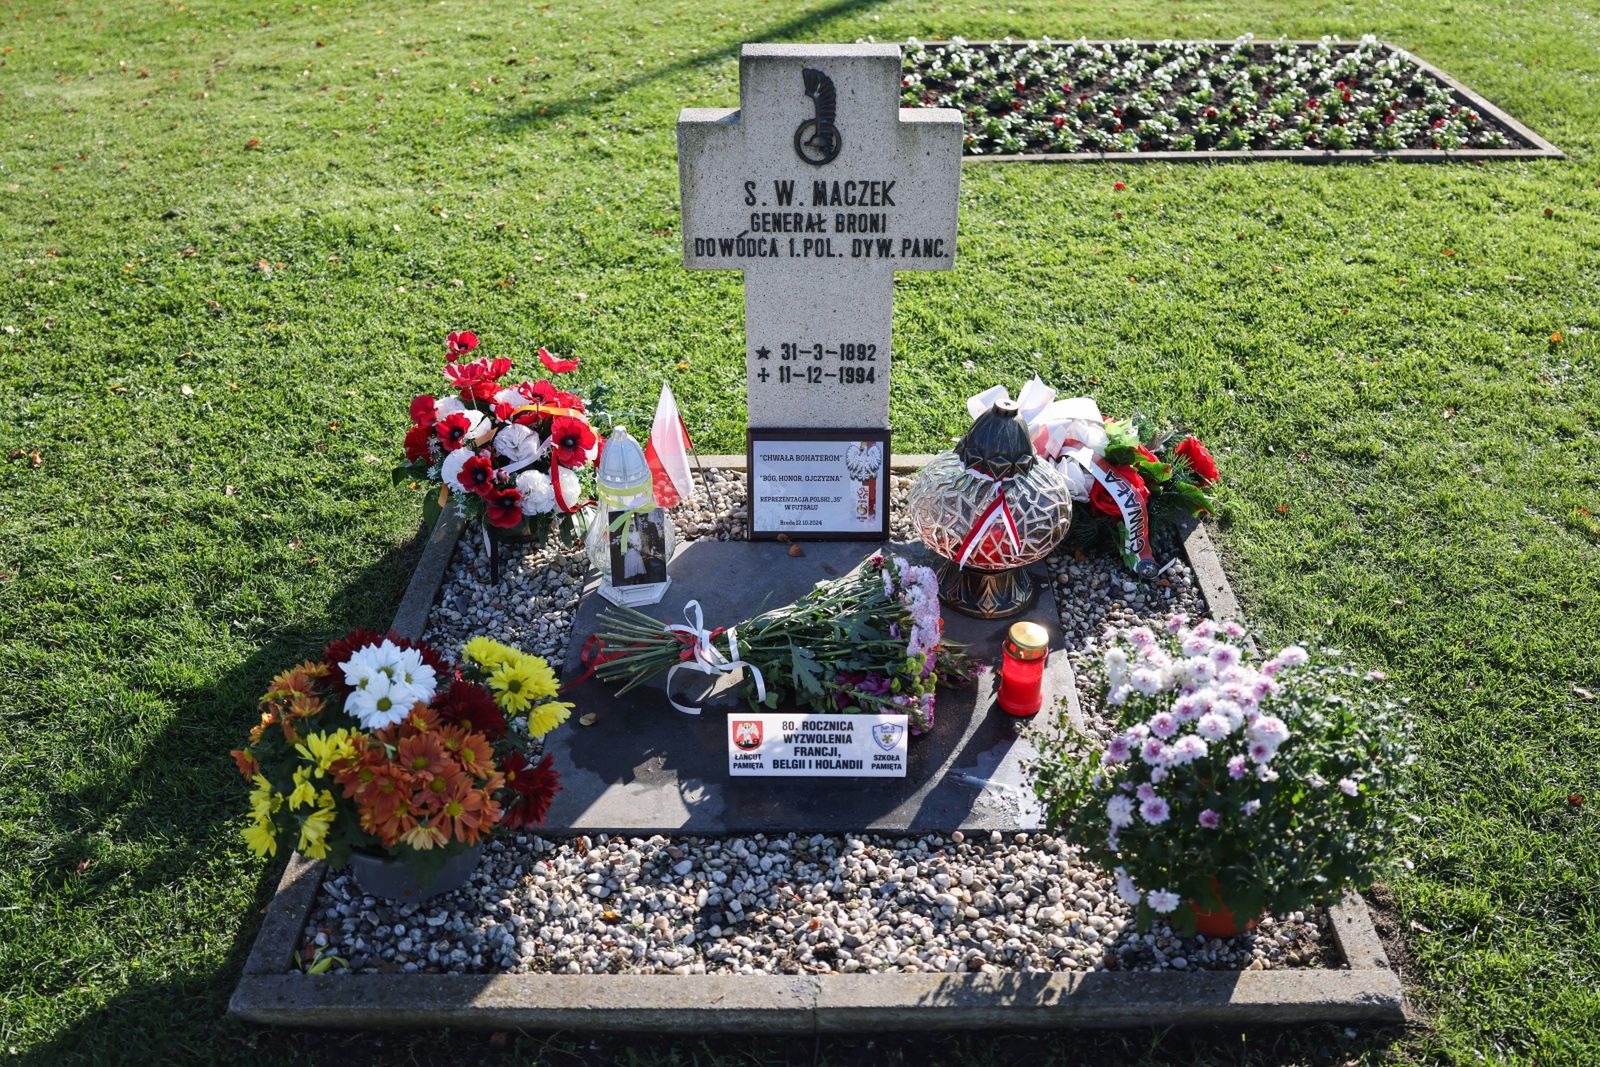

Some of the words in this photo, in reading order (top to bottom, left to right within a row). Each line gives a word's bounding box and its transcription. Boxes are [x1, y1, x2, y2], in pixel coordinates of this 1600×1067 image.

[743, 180, 767, 207] S.
[773, 179, 804, 207] W.
[812, 180, 896, 207] MACZEK
[751, 212, 827, 233] GENERAŁ
[835, 213, 887, 233] BRONI
[694, 230, 779, 258] DOWÓDCA
[851, 238, 896, 258] DYW.
[901, 238, 950, 258] PANC.
[1104, 468, 1146, 554] CHWAŁA
[782, 720, 799, 732] 80.
[802, 720, 854, 732] ROCZNICA
[783, 733, 853, 745] WYZWOLENIA
[734, 753, 762, 761] ŁAŃCUT
[794, 746, 842, 759] FRANCJI,
[873, 754, 900, 762] SZKOŁA
[733, 762, 764, 770] PAMIĘTA
[772, 759, 806, 770] BELGII
[809, 759, 813, 770] I
[815, 759, 863, 770] HOLANDII
[871, 763, 902, 771] PAMIĘTA
